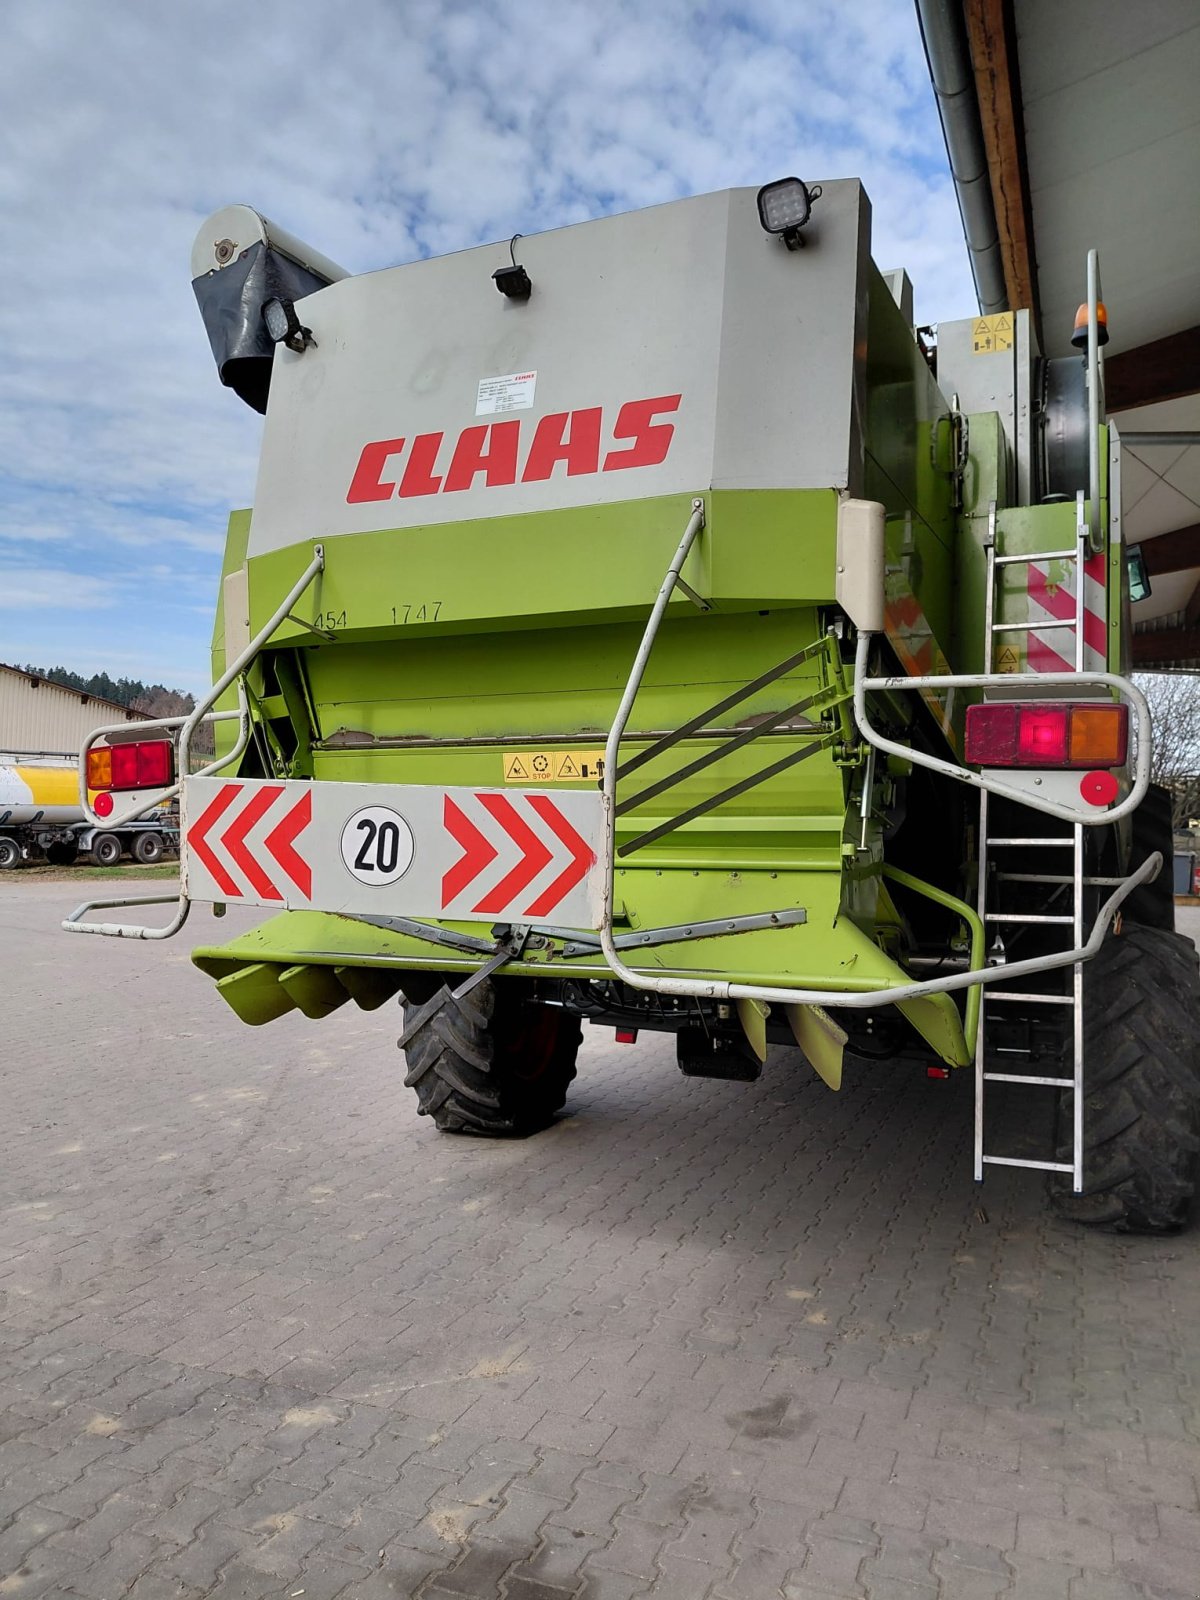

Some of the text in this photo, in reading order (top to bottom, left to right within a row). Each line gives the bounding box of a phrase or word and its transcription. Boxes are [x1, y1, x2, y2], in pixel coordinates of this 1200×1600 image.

[346, 393, 682, 504] CLAAS
[314, 601, 442, 629] 454 1747
[532, 772, 552, 780] STOP
[354, 819, 400, 873] 20
